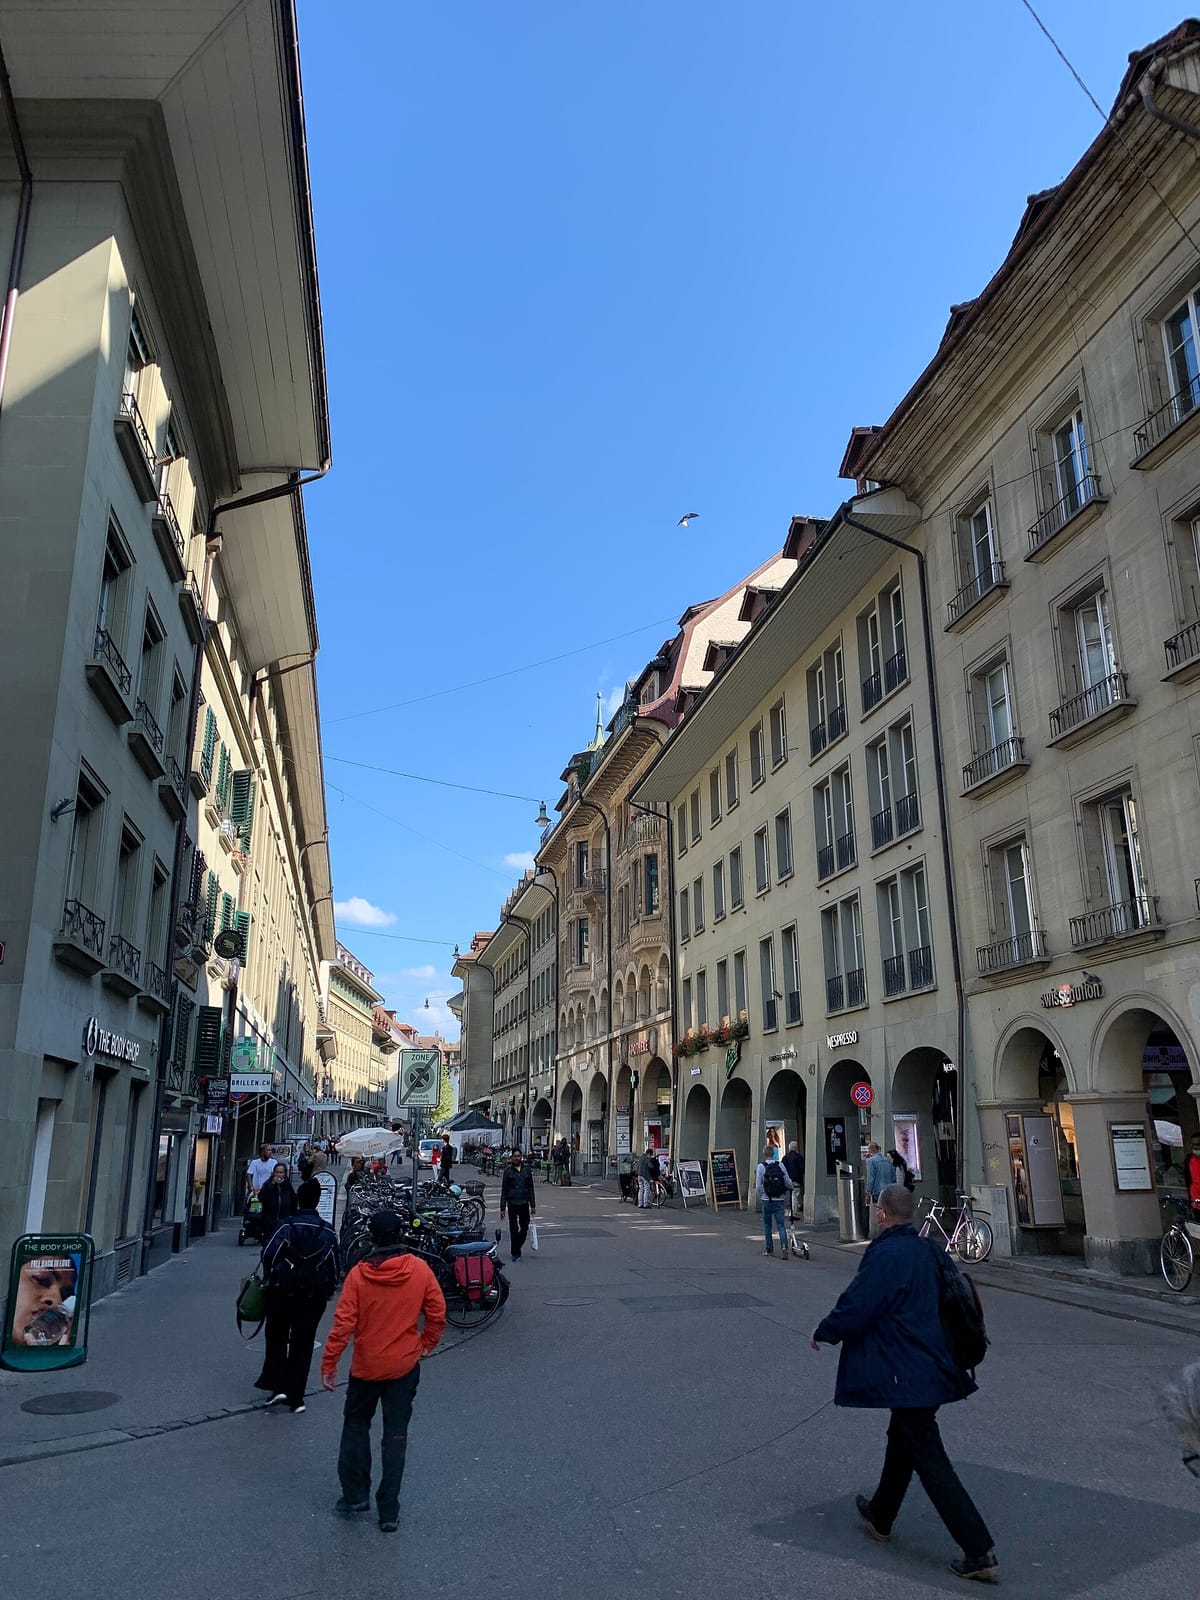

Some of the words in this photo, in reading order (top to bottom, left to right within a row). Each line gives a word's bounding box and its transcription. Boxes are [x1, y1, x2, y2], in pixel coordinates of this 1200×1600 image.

[99, 1029, 111, 1053] THE
[111, 1034, 127, 1058] BODY
[125, 1039, 140, 1062] SHOP
[826, 1031, 857, 1050] NESPRESSO
[231, 1079, 271, 1087] BRILLEN.CH
[63, 1243, 82, 1251] SHOP
